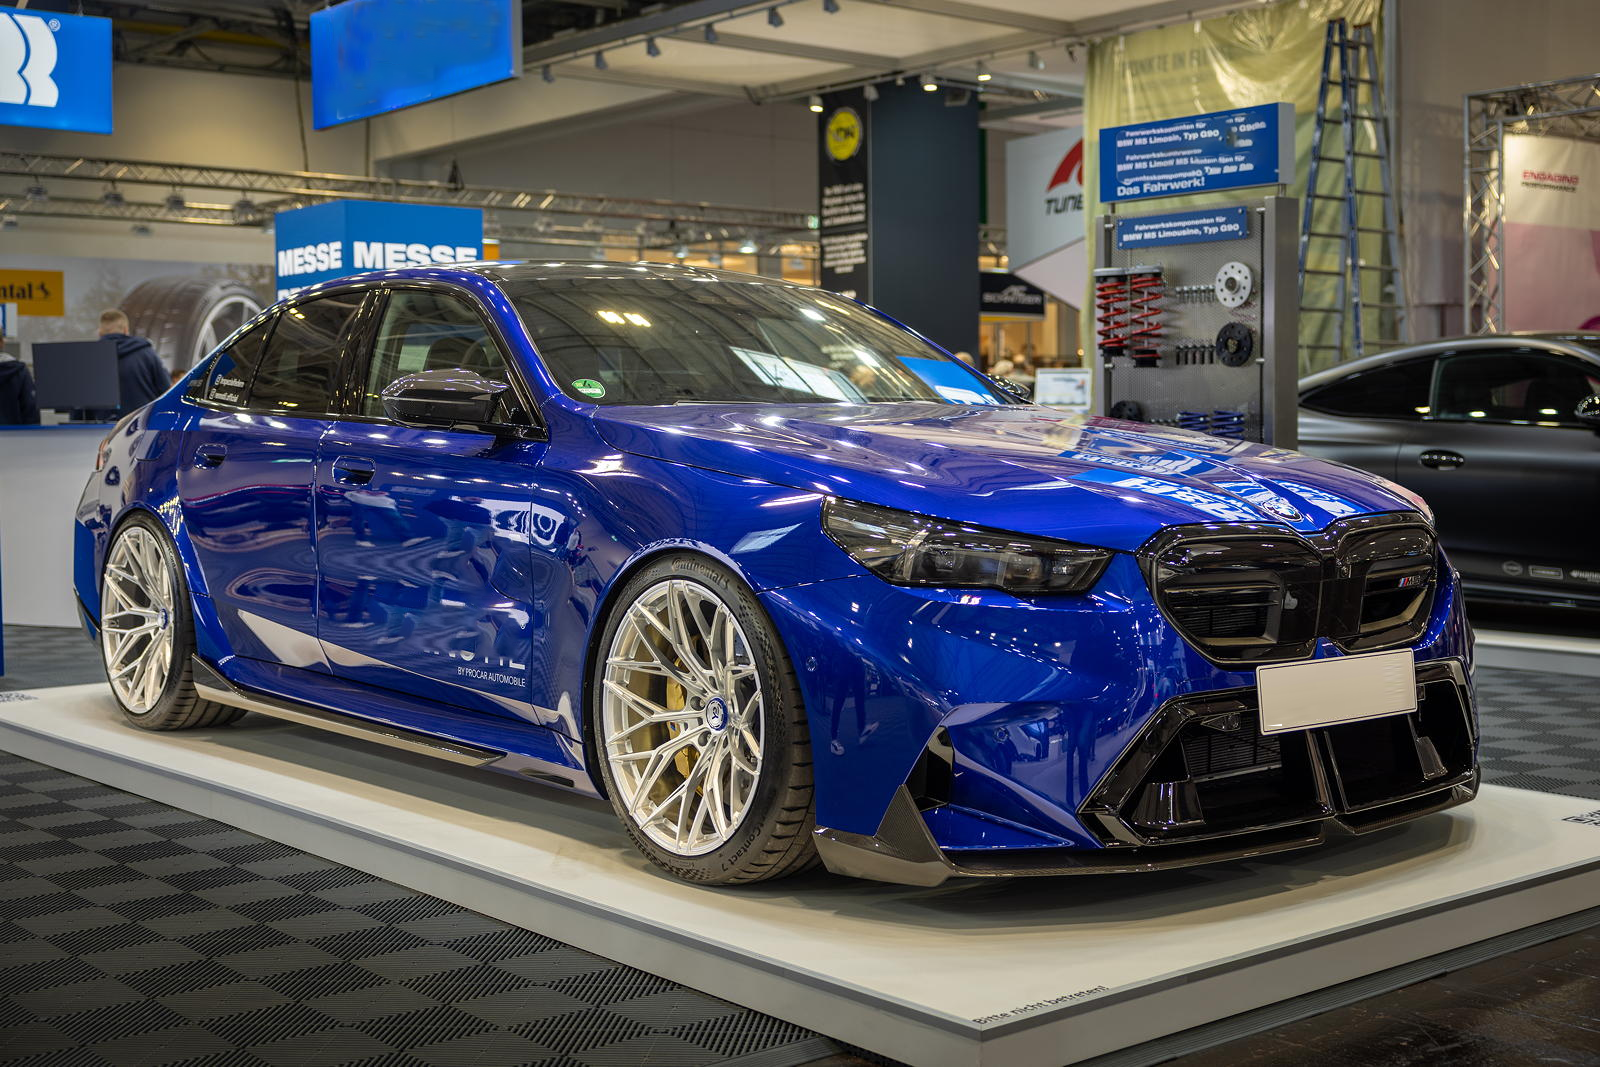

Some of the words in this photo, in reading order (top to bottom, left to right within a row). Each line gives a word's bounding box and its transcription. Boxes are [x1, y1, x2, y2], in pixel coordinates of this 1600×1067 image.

[1183, 131, 1199, 141] Typ
[1116, 185, 1141, 197] Das
[1143, 176, 1206, 194] Fahrwerk!
[1122, 233, 1143, 242] BMW
[1143, 230, 1157, 240] M5
[1158, 227, 1202, 239] Limousine,
[1203, 225, 1219, 235] Typ
[1220, 223, 1240, 233] G90
[1134, 217, 1215, 231] Fahrwerkskomponenten
[1215, 215, 1227, 223] für
[277, 241, 342, 277] MESSE
[352, 240, 478, 270] MESSE
[457, 666, 465, 676] BY
[465, 667, 488, 680] PROCAR
[488, 671, 526, 688] AUTOMOBILE
[971, 1011, 1011, 1025] Bitte
[1010, 1000, 1048, 1014] nicht
[1043, 984, 1109, 1005] betreten!
